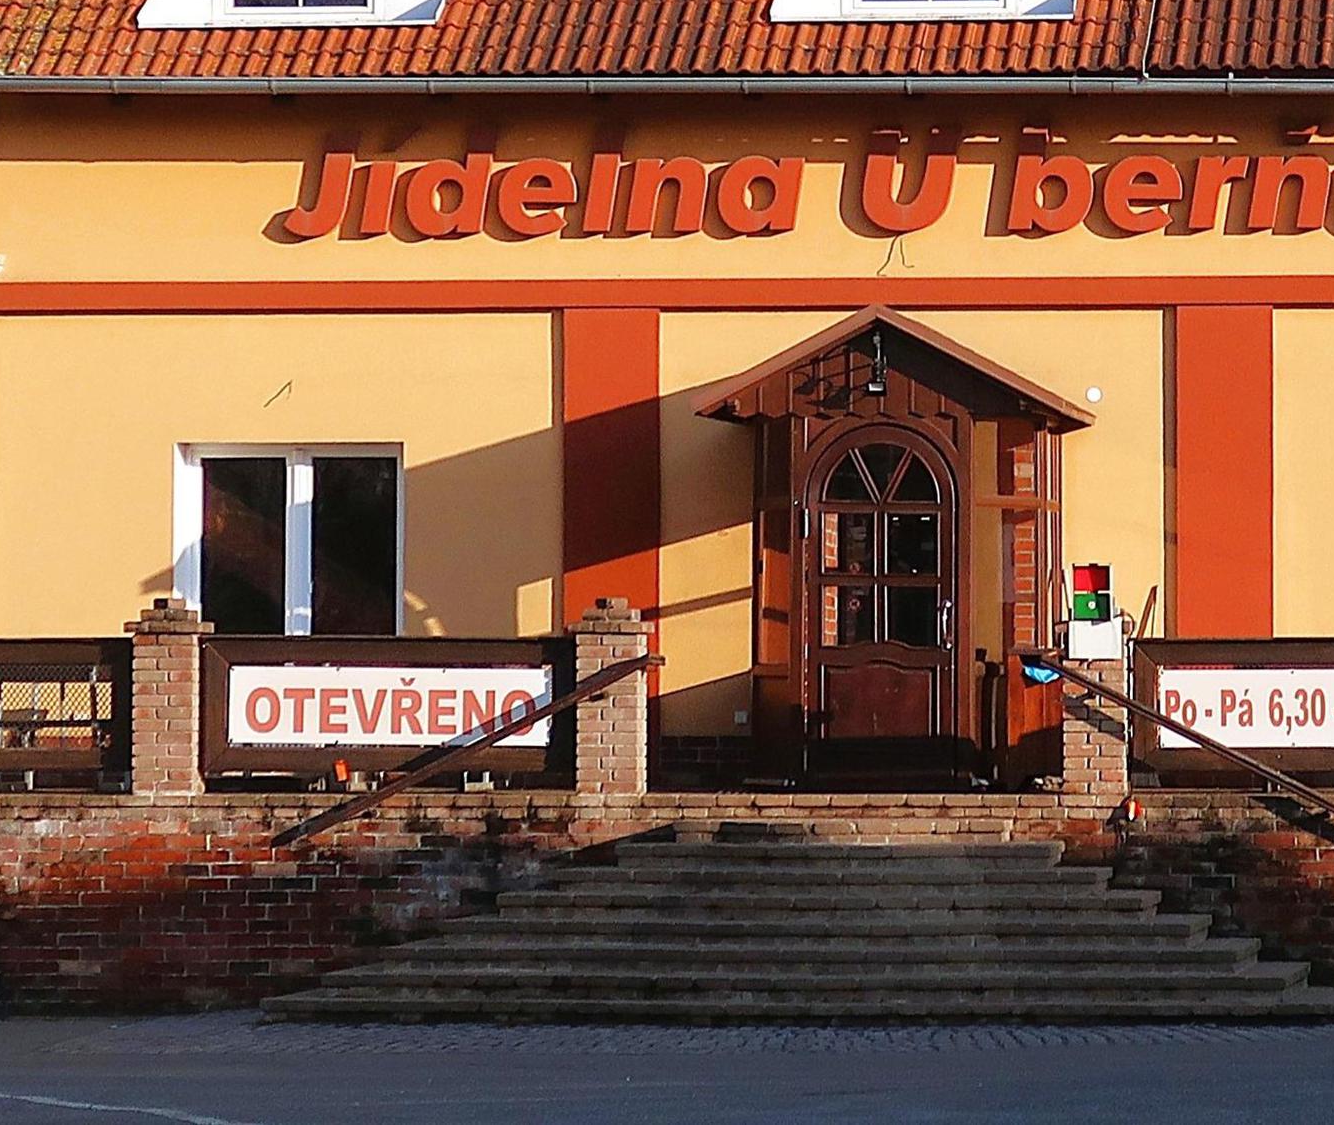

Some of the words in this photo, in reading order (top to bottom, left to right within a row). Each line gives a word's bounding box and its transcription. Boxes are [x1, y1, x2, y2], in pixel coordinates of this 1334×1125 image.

[862, 124, 960, 232] U
[245, 678, 535, 736] OTEVŘENO
[1165, 689, 1197, 727] Po
[1220, 689, 1253, 726] Pá
[1268, 688, 1326, 735] 6,30
